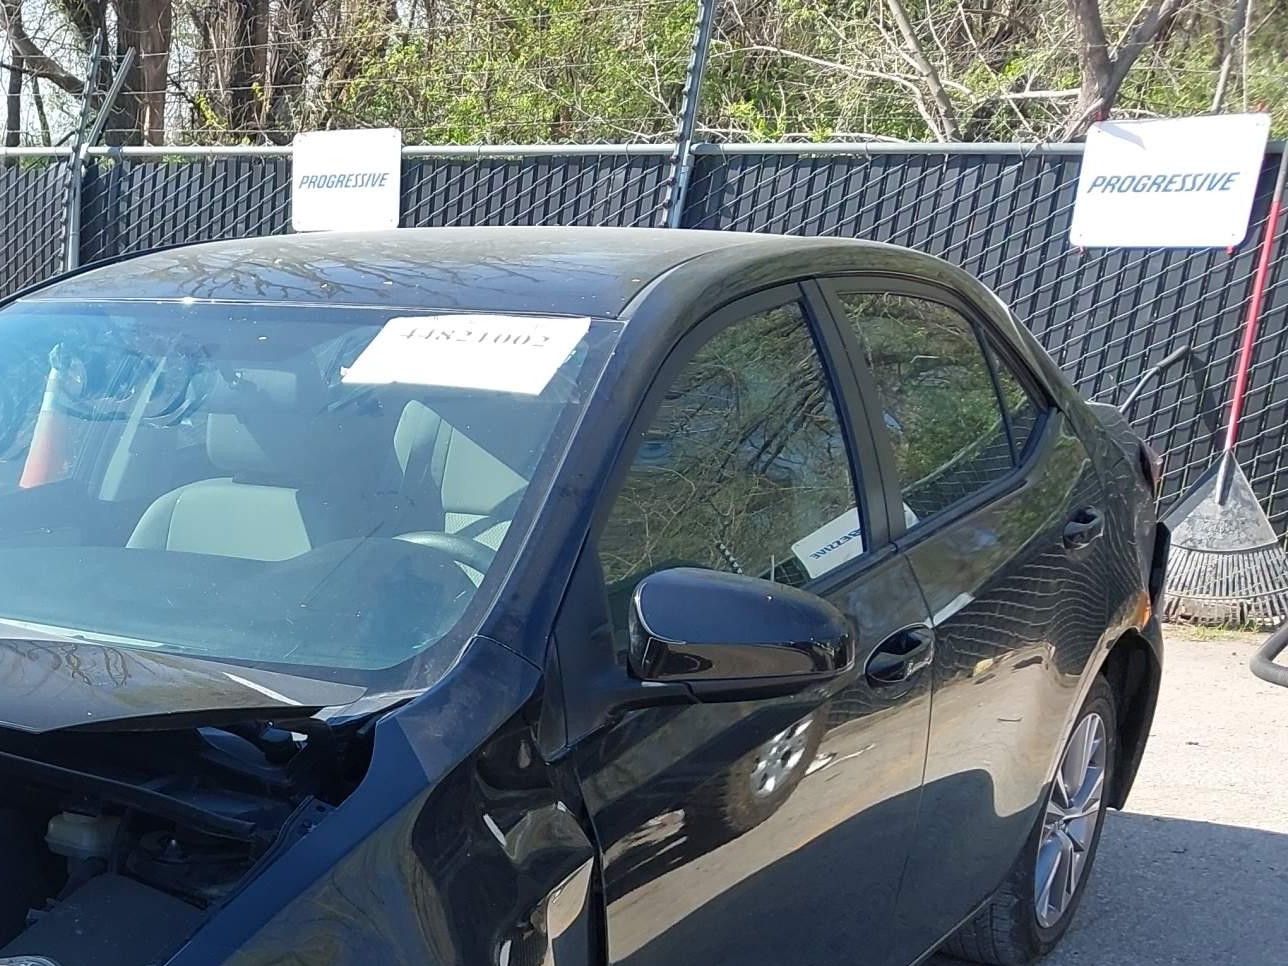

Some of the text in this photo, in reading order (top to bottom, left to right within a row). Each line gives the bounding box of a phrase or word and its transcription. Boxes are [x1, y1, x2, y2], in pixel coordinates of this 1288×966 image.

[298, 172, 390, 189] PROGRESSIVE
[1087, 171, 1241, 194] PROGRESSIVE
[401, 328, 550, 347] 44821002
